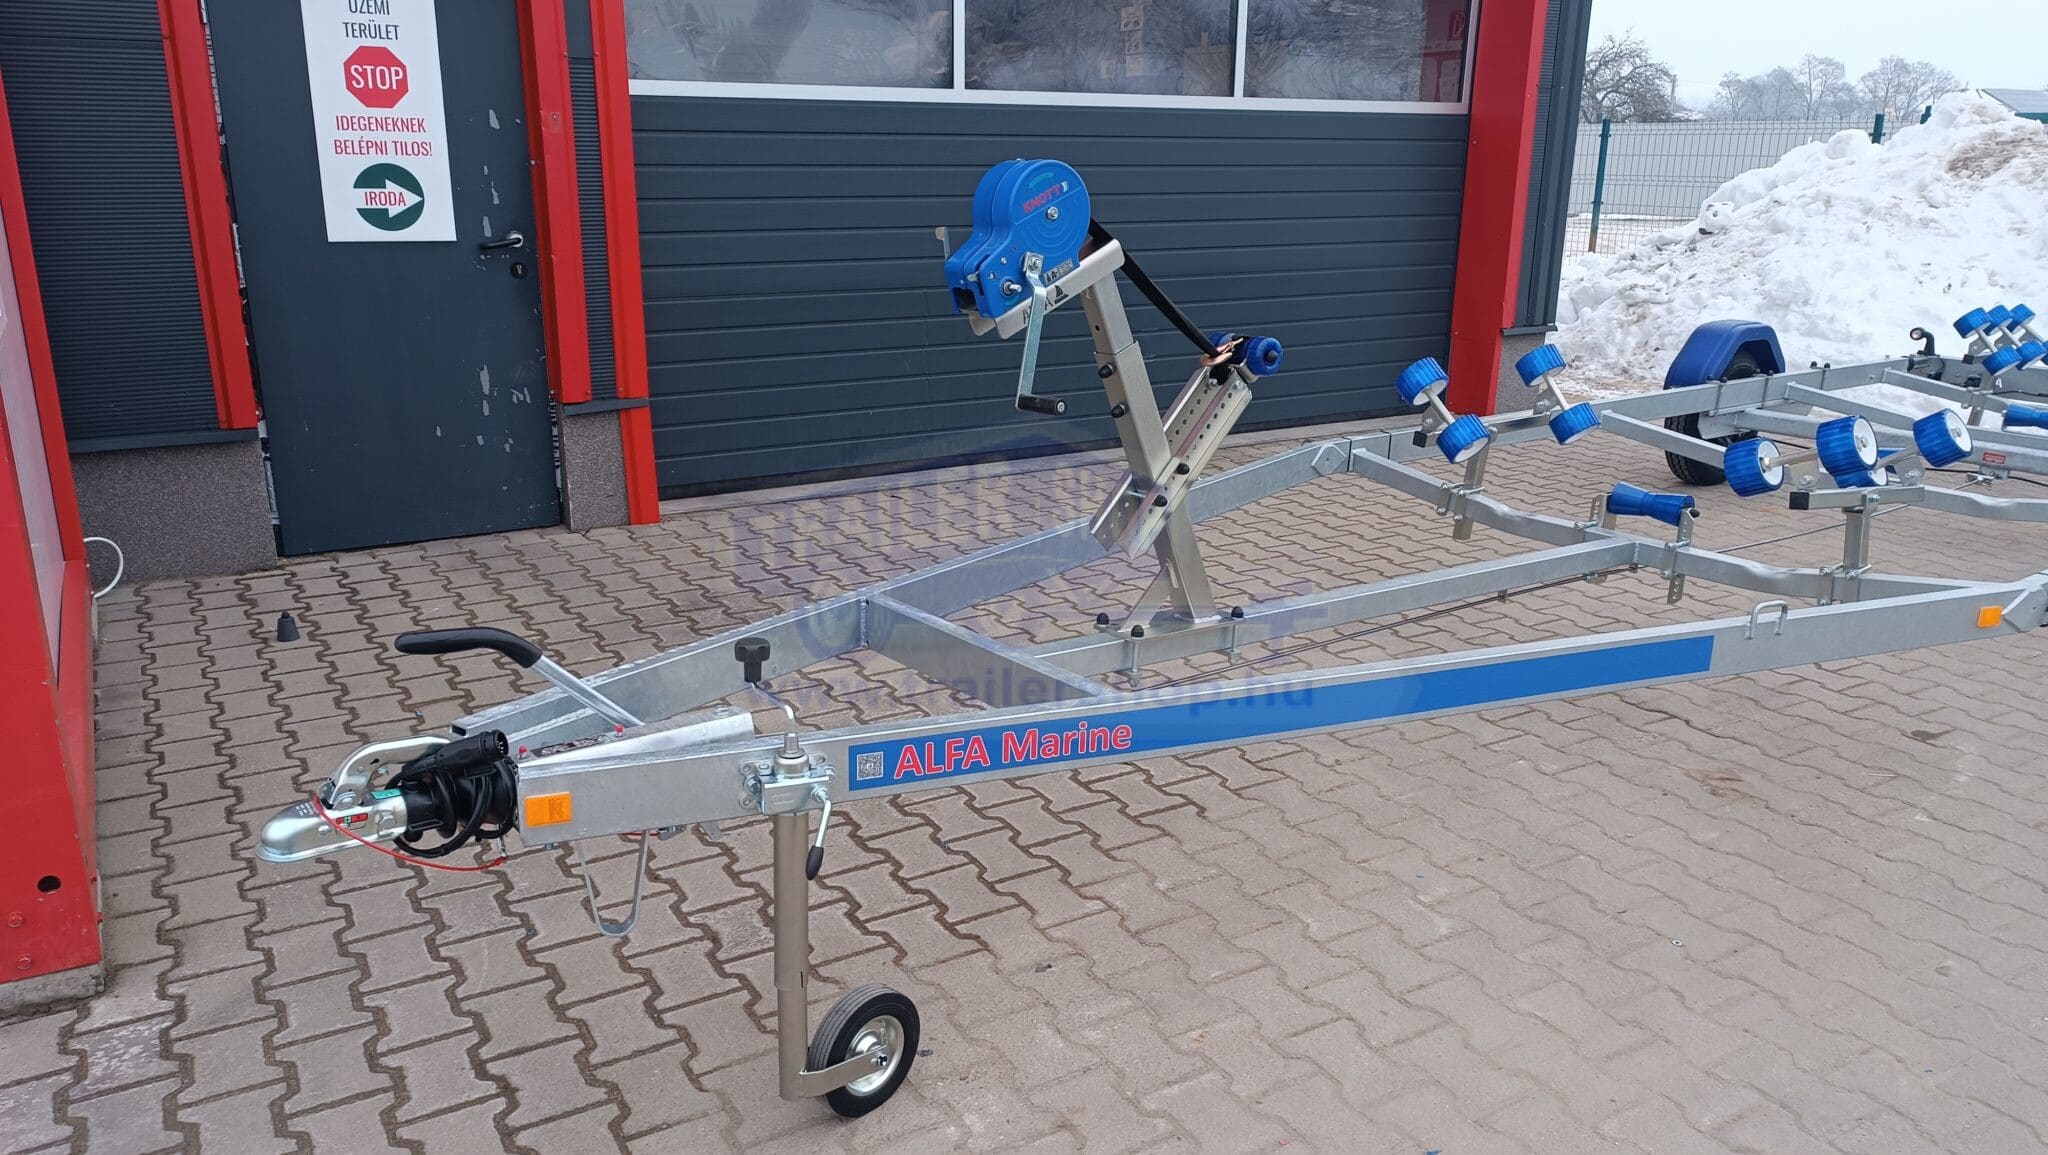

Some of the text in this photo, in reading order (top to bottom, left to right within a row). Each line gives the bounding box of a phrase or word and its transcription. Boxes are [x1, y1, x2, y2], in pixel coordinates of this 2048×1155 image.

[342, 19, 399, 40] TERÜLET
[350, 64, 404, 90] STOP
[335, 115, 427, 133] IDEGENEKNEK
[333, 137, 433, 157] BELÉPNI TILOS!
[364, 191, 407, 207] IRODA
[893, 720, 1133, 780] ALFA Marine
